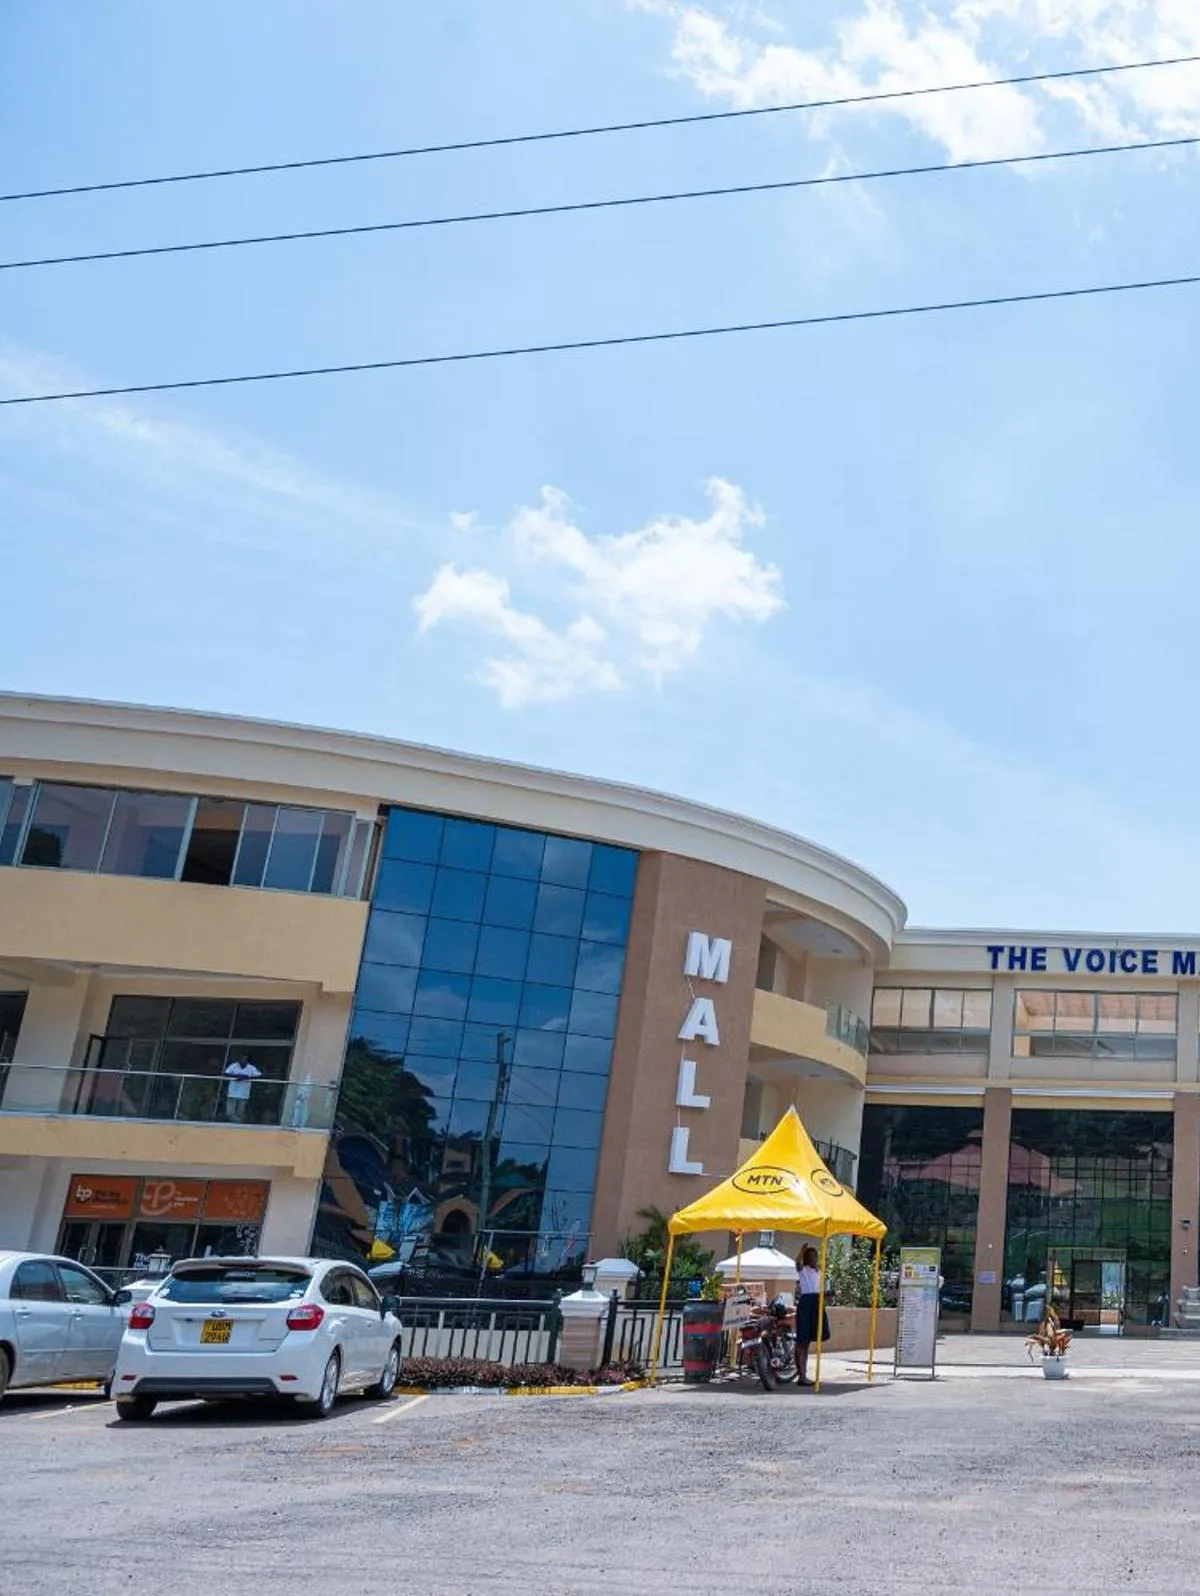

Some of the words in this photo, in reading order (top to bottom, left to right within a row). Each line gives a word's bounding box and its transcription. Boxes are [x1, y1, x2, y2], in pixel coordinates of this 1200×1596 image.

[986, 945, 1047, 971] THE
[1063, 947, 1158, 974] VOICE
[668, 931, 732, 1176] MALL
[746, 1174, 783, 1187] MTN
